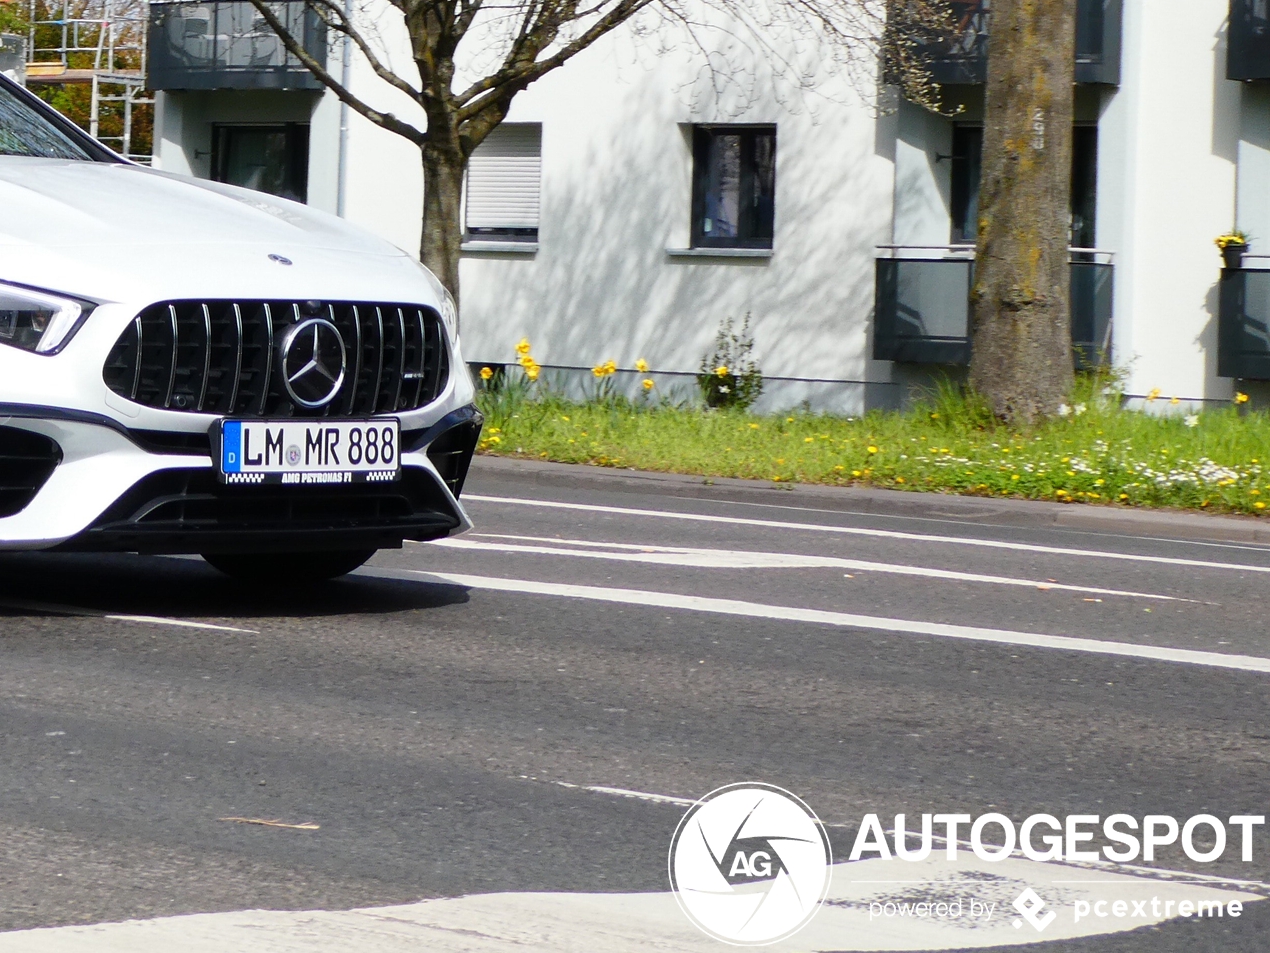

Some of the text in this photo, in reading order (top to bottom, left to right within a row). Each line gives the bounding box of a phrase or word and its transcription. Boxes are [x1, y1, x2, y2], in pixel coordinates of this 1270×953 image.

[244, 427, 394, 466] LM MR 888
[228, 452, 236, 464] D
[281, 473, 300, 483] AMG
[301, 472, 343, 483] PETRONAS
